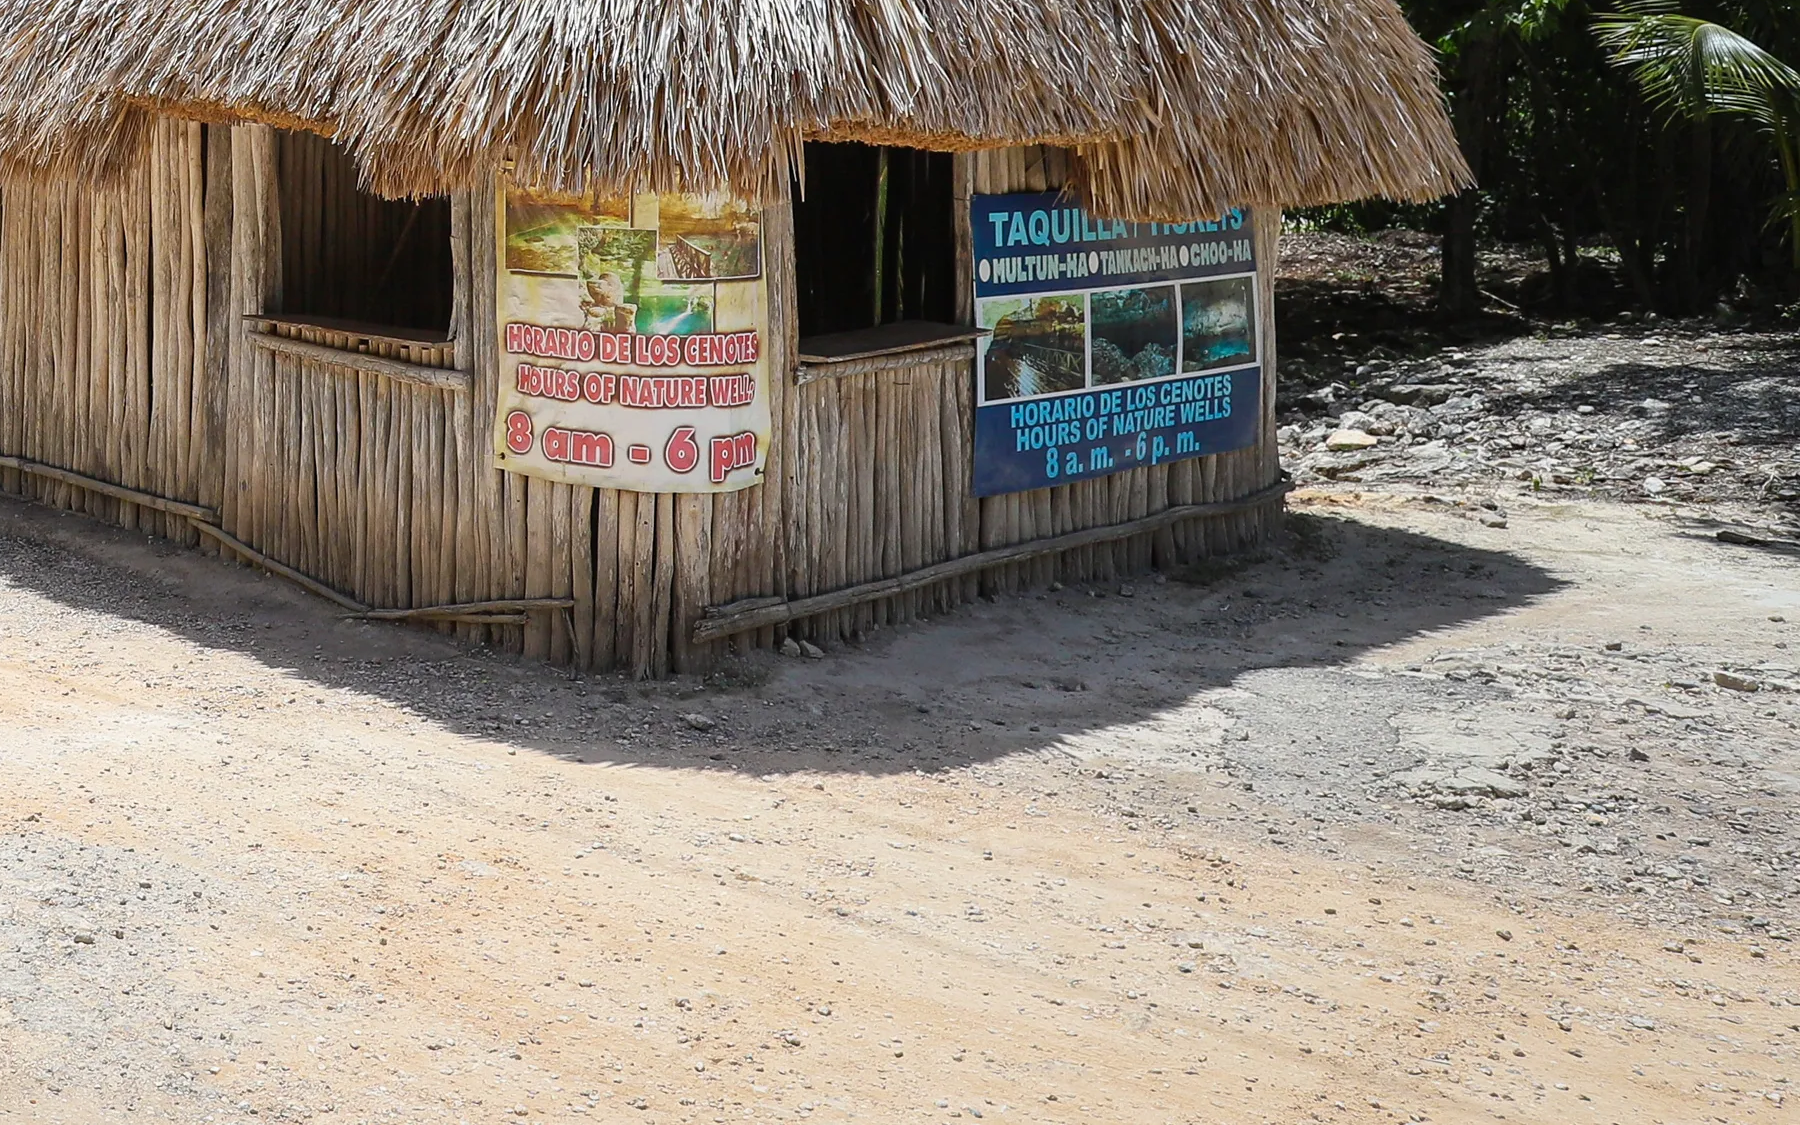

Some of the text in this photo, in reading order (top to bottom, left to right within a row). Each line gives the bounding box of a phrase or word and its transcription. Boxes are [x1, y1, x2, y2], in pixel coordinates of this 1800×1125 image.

[989, 208, 1128, 247] TAQUILLA
[992, 239, 1252, 284] MULTUN-HA TANKACH-HA CHOO-HA
[507, 324, 759, 365] HORARIO DE LOS CENOTES
[518, 364, 580, 401] HOURS
[584, 373, 616, 403] OF
[620, 376, 707, 407] NATURE
[1011, 375, 1232, 428] HORARIO DE LOS CENOTES
[507, 411, 533, 454] 8
[543, 427, 614, 468] am
[666, 426, 699, 473] 6
[711, 431, 756, 483] pm
[1017, 396, 1232, 452] HOURS OF NATURE WELLS
[1045, 447, 1059, 478] 8
[1135, 430, 1147, 461] 6
